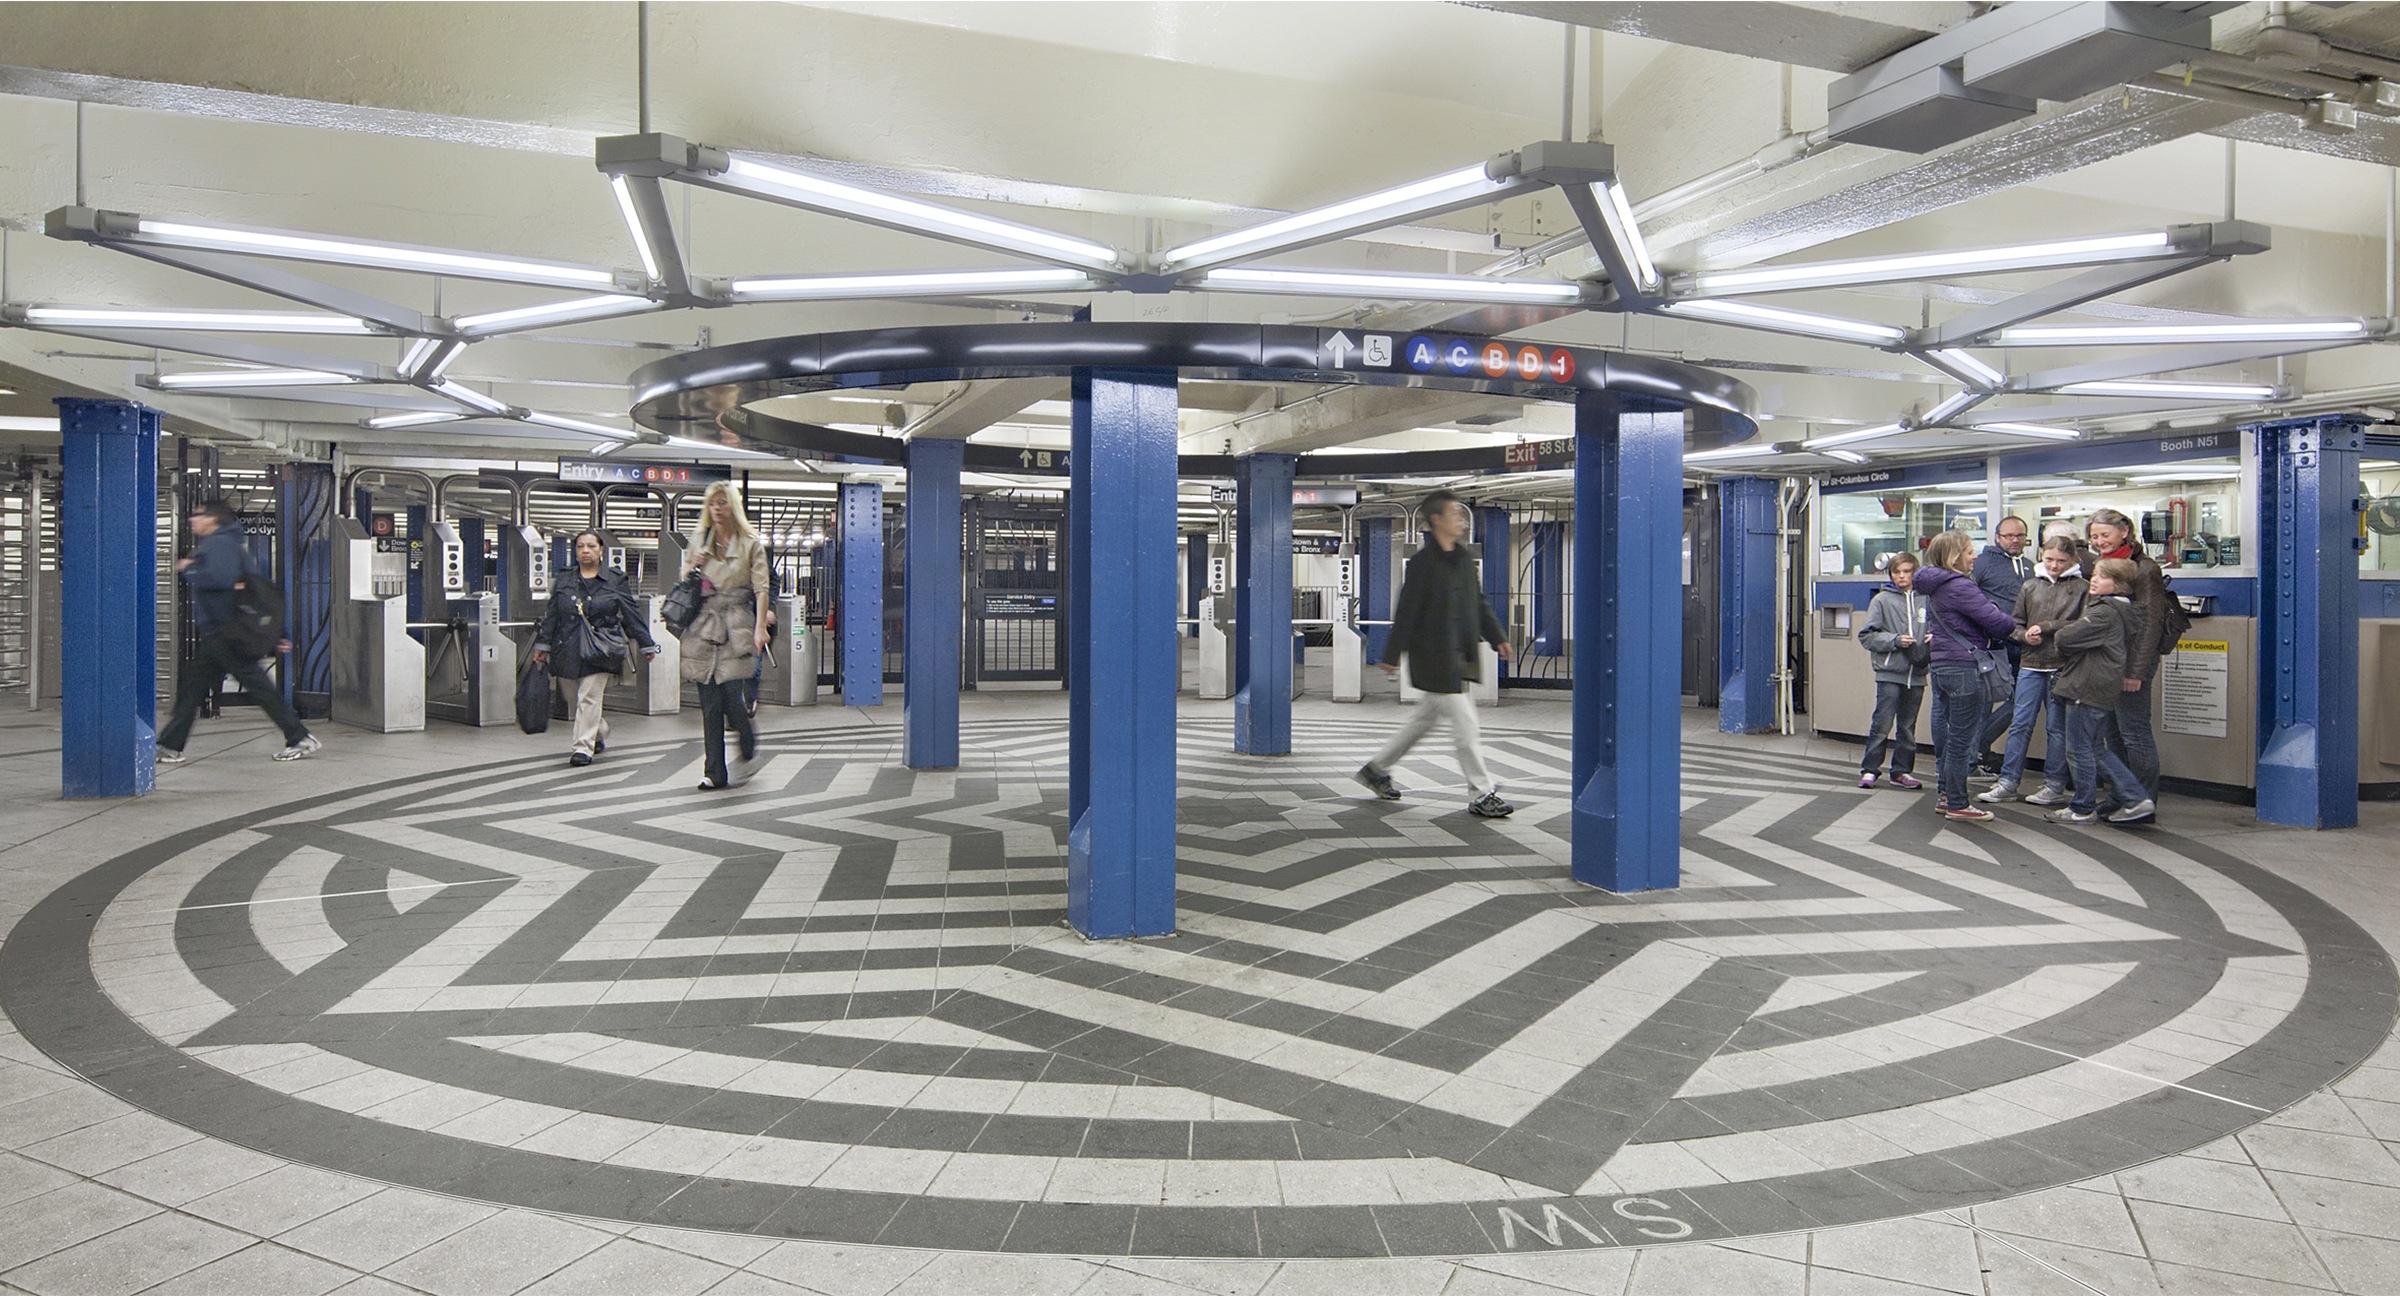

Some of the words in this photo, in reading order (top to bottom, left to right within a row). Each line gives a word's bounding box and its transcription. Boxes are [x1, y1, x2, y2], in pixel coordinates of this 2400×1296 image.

[1413, 343, 1430, 364] A
[1452, 346, 1468, 367] C
[1489, 350, 1503, 369] B
[1523, 352, 1537, 372] D
[1557, 356, 1566, 375] 1
[2161, 439, 2193, 452] Booth
[2197, 435, 2218, 447] N51
[1505, 444, 1535, 463] Exit
[1539, 441, 1552, 455] 58
[1554, 440, 1565, 453] St
[1567, 439, 1575, 452] &
[1061, 455, 1070, 466] A
[560, 463, 604, 481] Entry
[615, 469, 624, 478] A
[631, 469, 640, 479] C
[648, 471, 655, 479] B
[663, 471, 672, 480] D
[680, 472, 686, 480] 1
[1871, 472, 1889, 481] Circle
[377, 521, 387, 531] D
[654, 644, 662, 654] 3
[795, 640, 802, 650] 5
[2194, 643, 2225, 651] Conduct
[487, 647, 493, 658] 1
